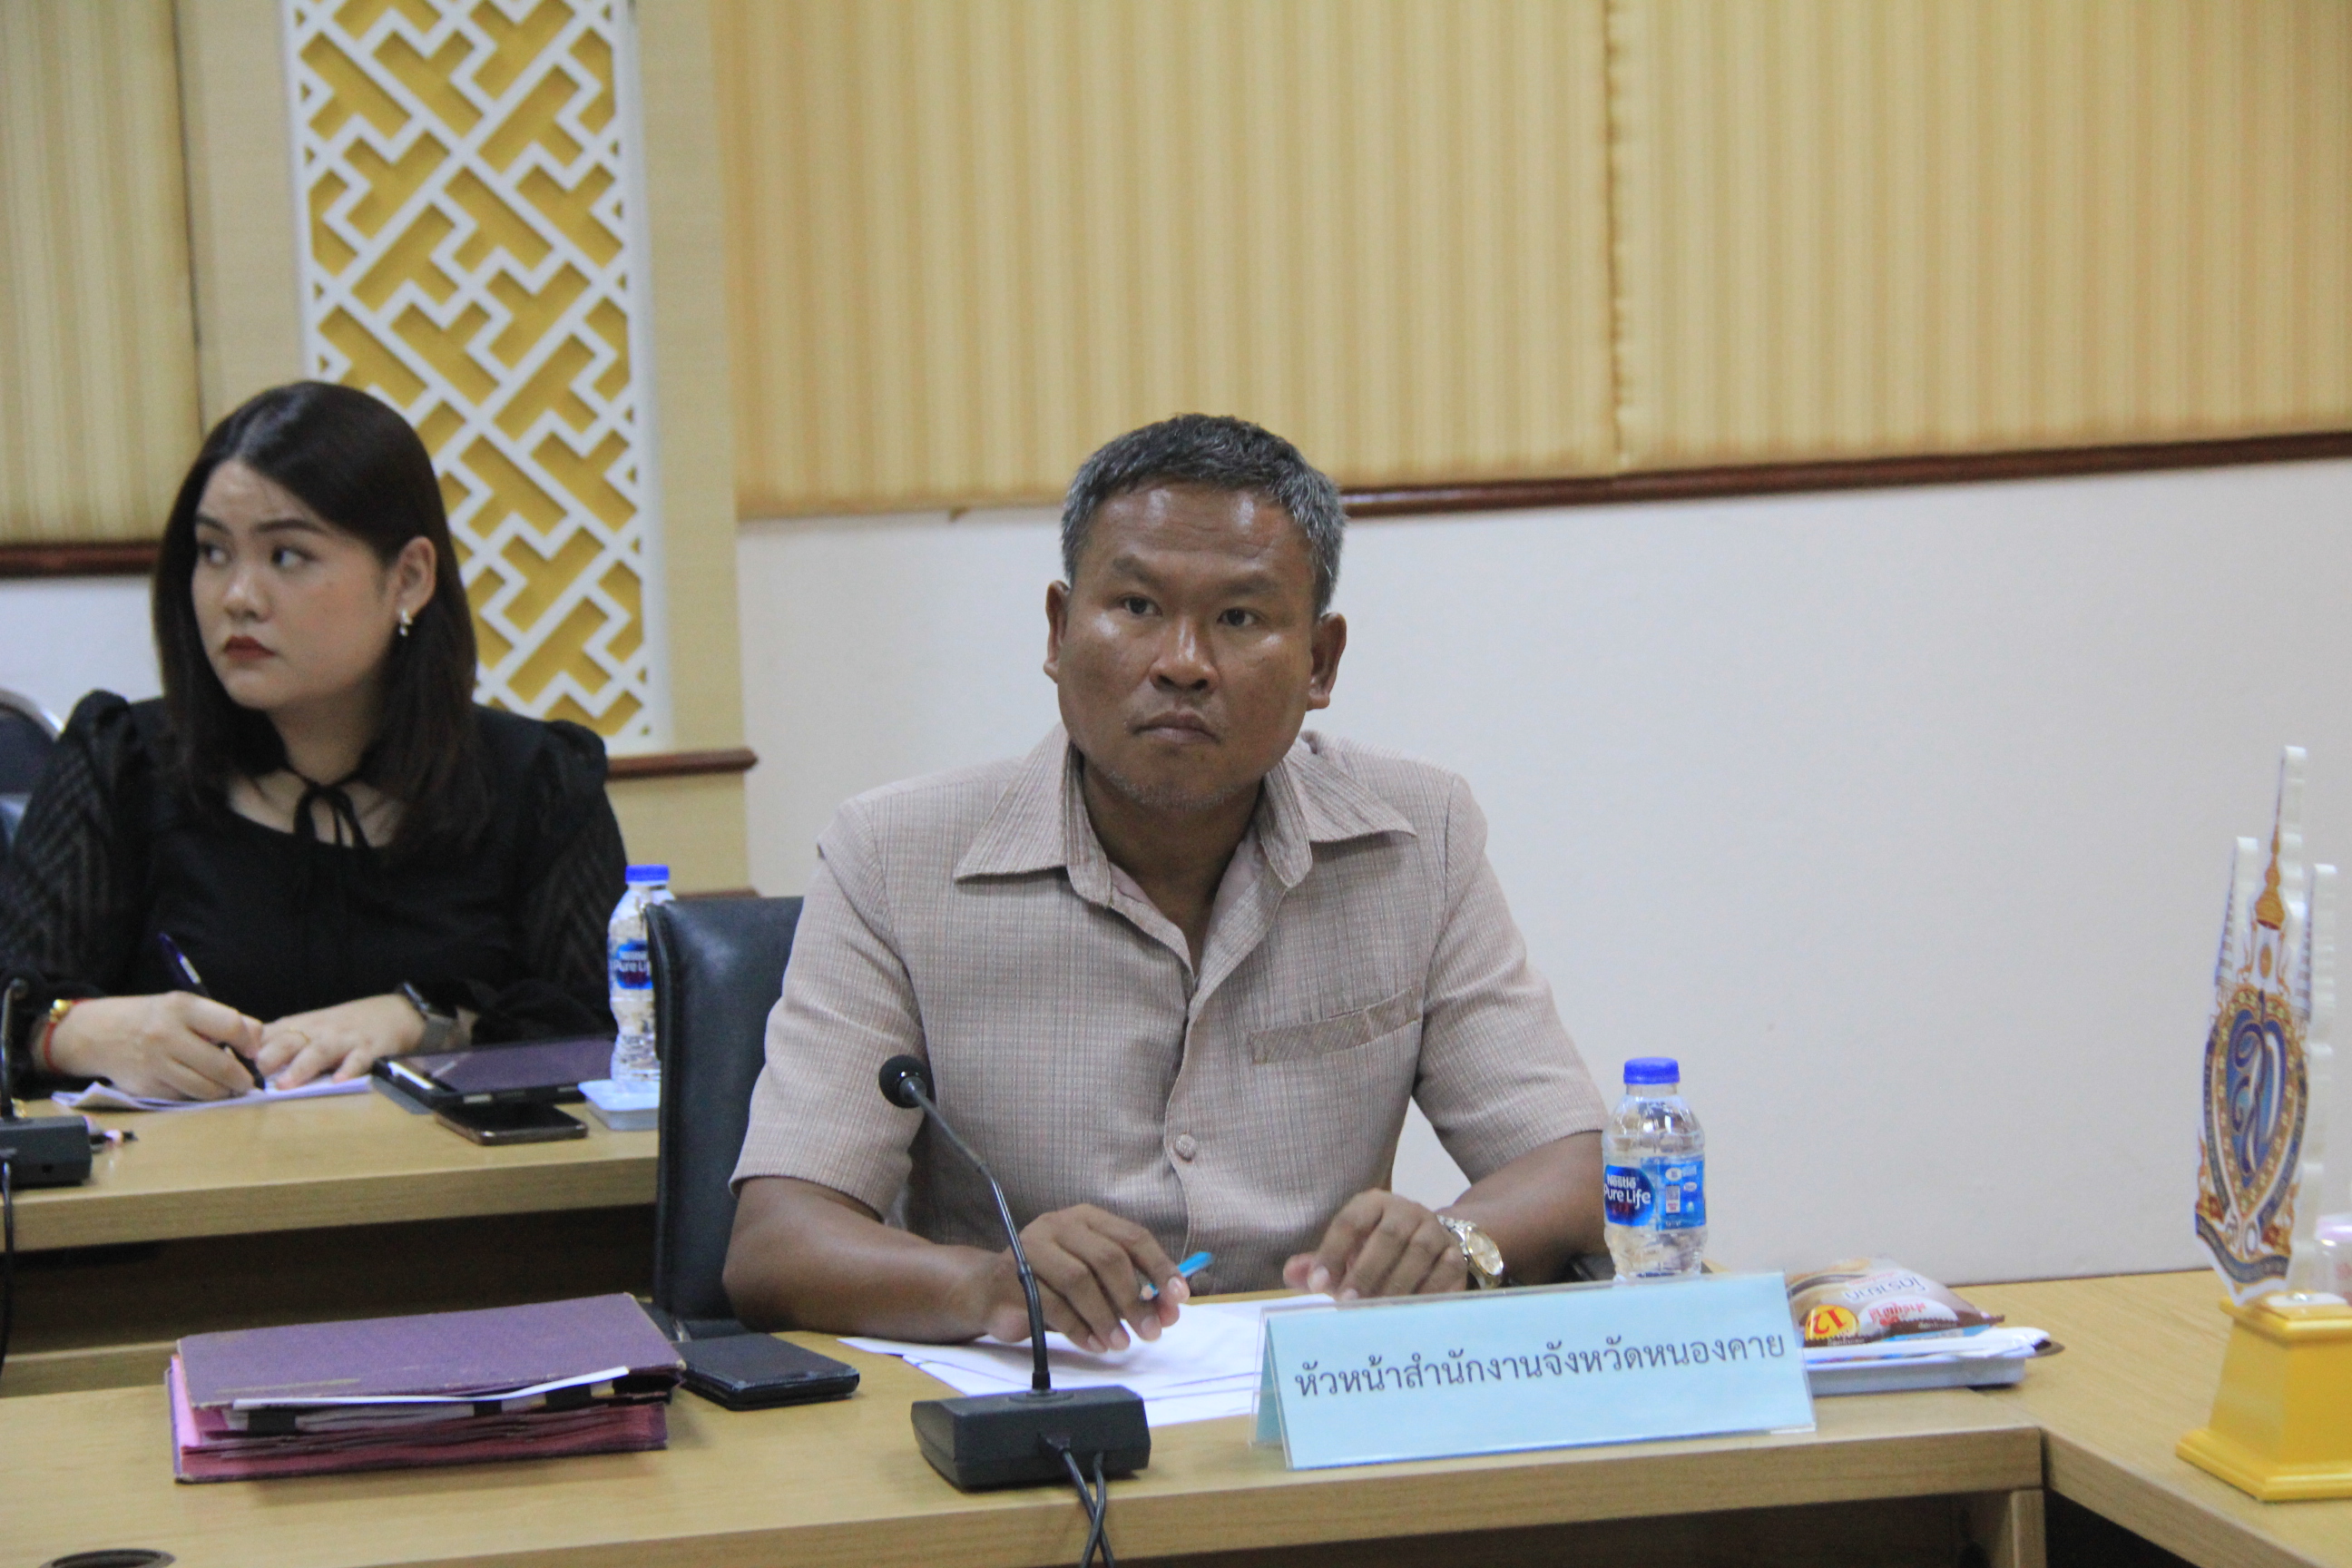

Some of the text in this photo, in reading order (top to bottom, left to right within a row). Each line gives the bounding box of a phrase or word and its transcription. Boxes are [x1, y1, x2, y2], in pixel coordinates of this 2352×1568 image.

[1603, 1183, 1624, 1202] Pure
[1626, 1189, 1651, 1210] Life
[1807, 1306, 1847, 1335] 12
[1294, 1334, 1786, 1397] หัวหน้าสำนักงานจังหวัดหนองคาย
